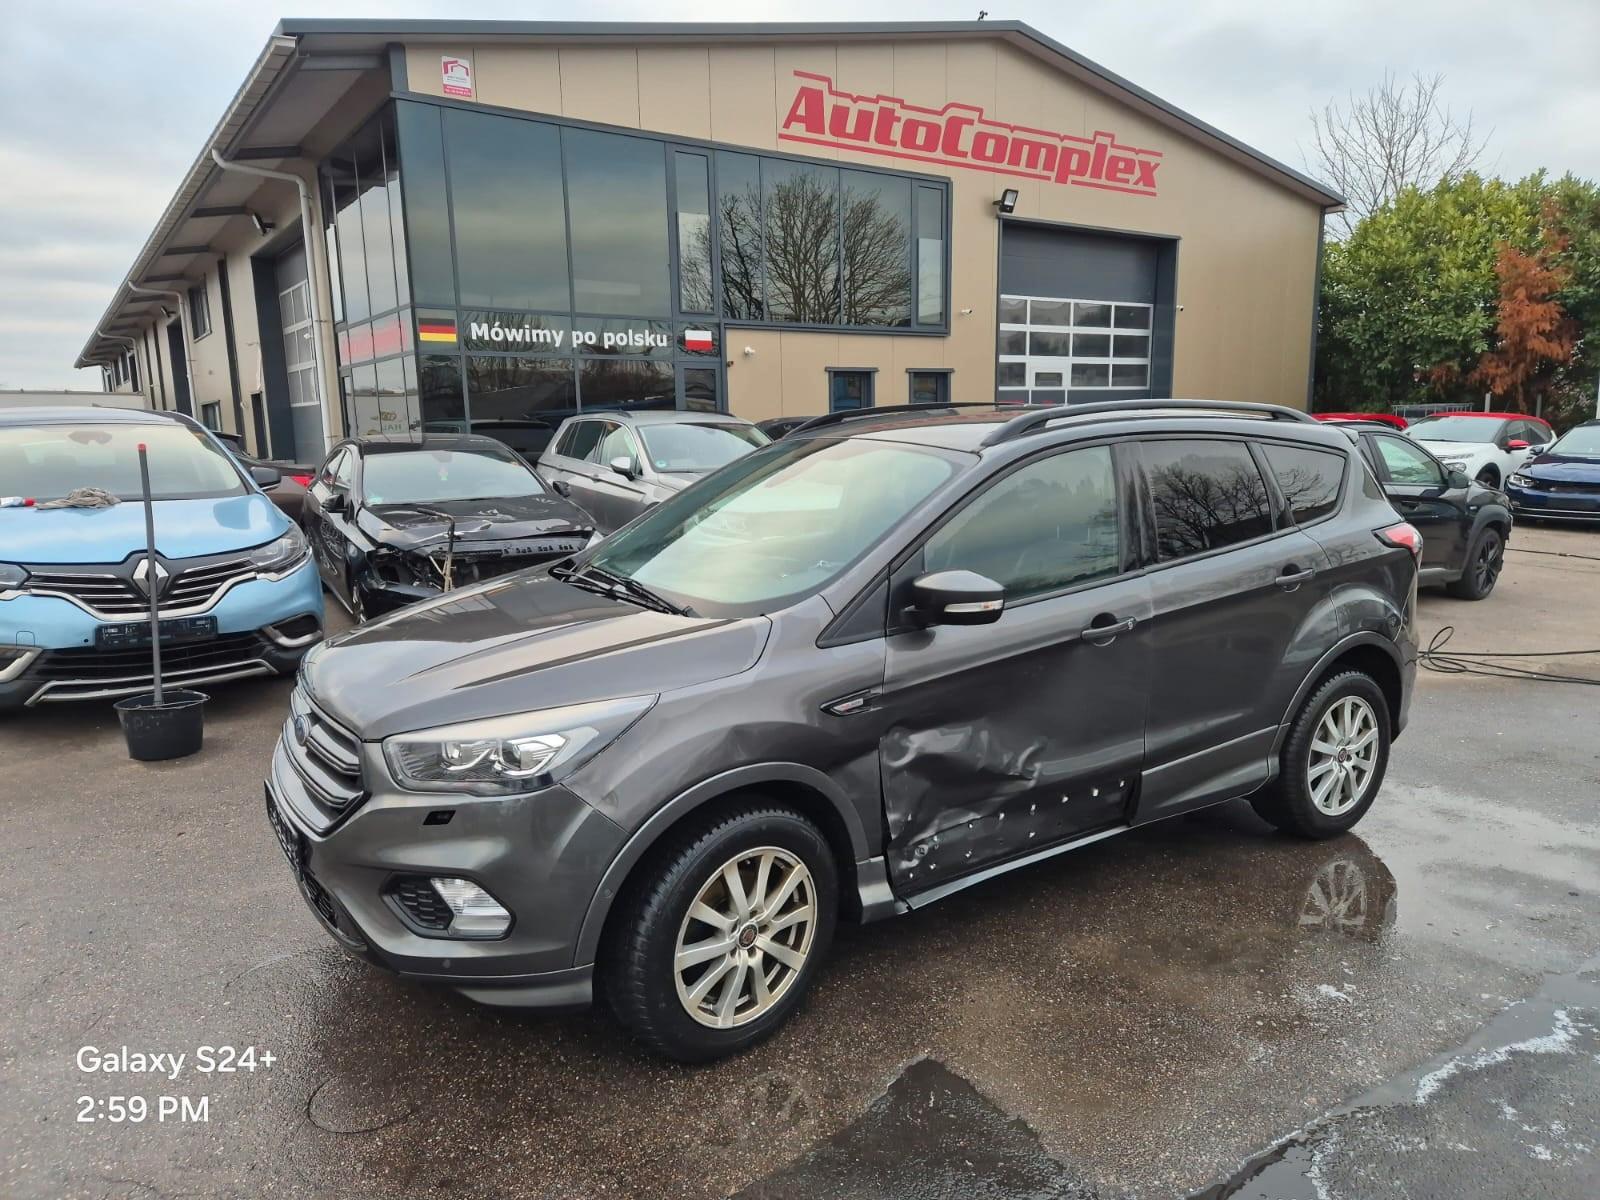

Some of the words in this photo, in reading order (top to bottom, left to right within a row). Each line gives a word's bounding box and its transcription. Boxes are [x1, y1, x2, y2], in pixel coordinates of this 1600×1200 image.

[782, 85, 1160, 189] AutoComplex
[470, 322, 564, 347] Mówimy
[571, 330, 597, 347] po
[603, 329, 668, 349] polsku
